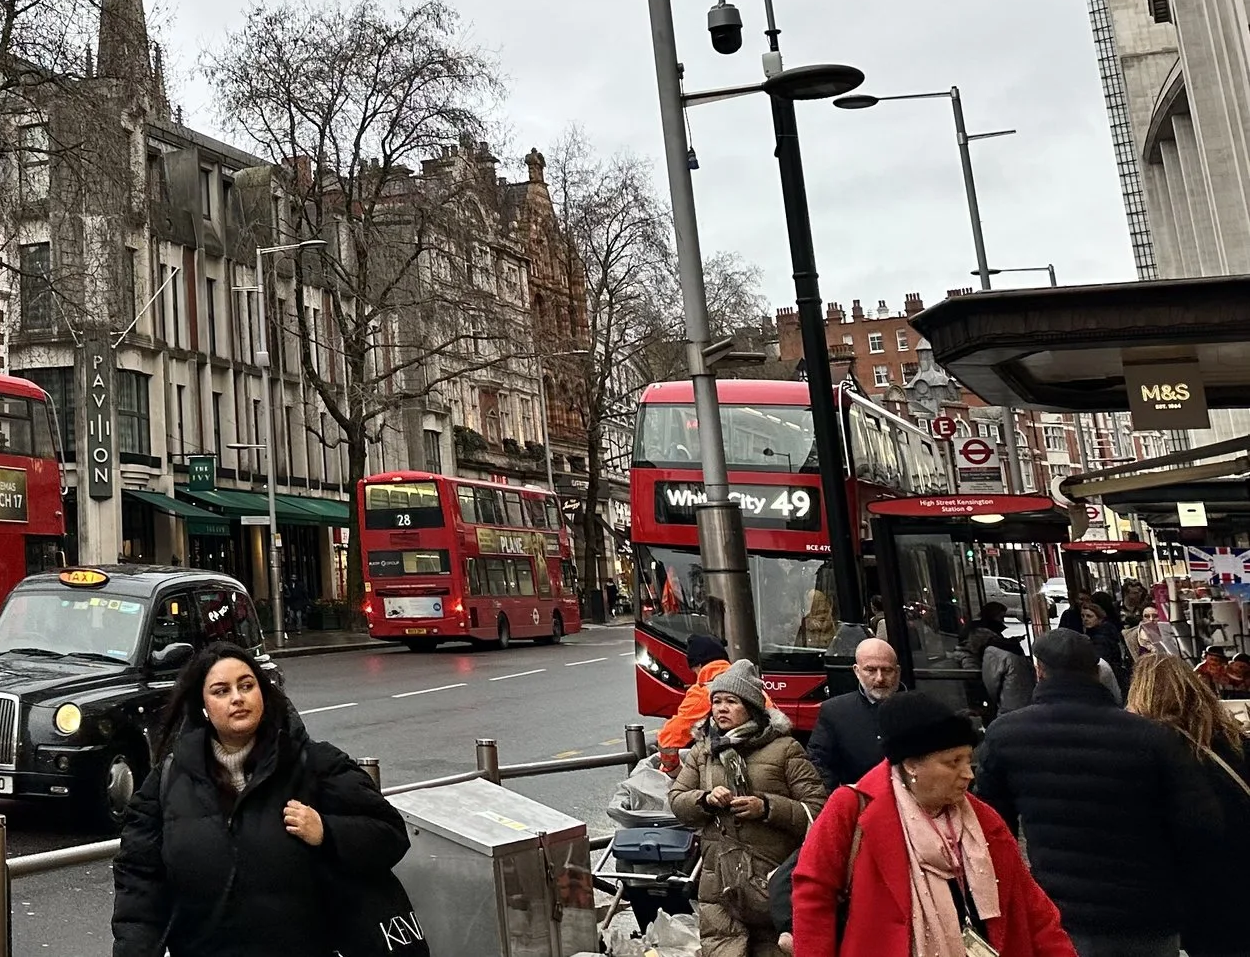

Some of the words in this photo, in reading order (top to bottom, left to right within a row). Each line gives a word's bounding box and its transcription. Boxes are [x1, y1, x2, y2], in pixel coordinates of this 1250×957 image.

[1140, 383, 1190, 402] M&S
[939, 420, 951, 435] E
[13, 494, 23, 509] 17
[666, 489, 708, 507] Whit
[727, 492, 767, 515] City
[771, 491, 811, 517] 49
[919, 499, 935, 507] High
[956, 498, 994, 507] Kensington
[941, 505, 965, 513] Station
[396, 514, 411, 526] 28
[499, 535, 525, 554] PLANE
[65, 572, 95, 583] TAXI
